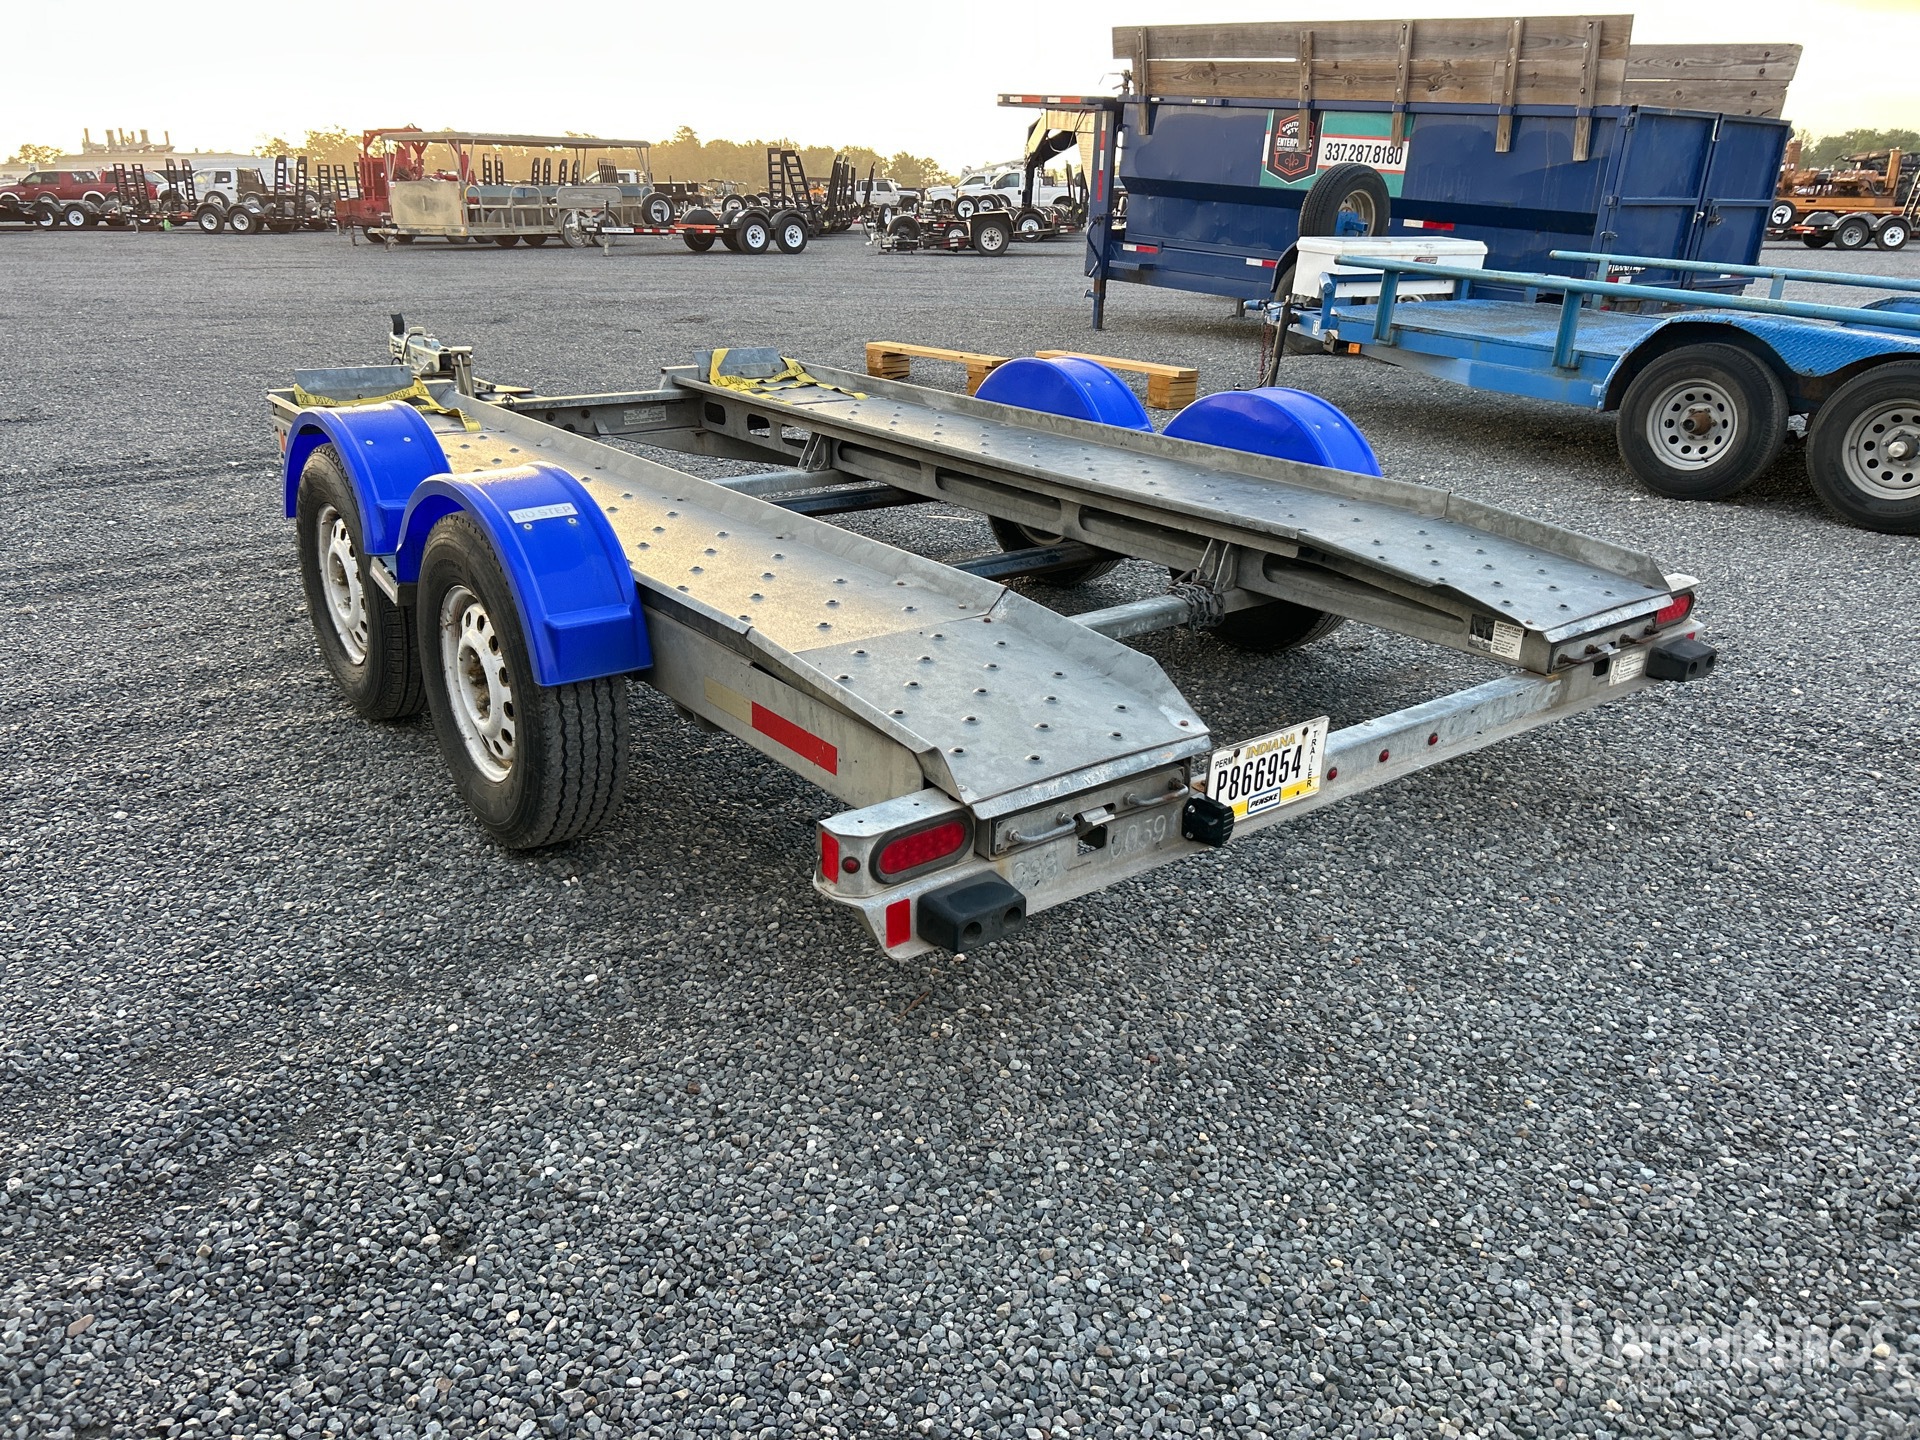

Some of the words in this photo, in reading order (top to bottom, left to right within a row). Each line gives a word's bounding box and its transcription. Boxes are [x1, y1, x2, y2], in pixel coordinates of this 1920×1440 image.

[1325, 142, 1403, 165] 337.287.8180
[514, 510, 535, 520] NO
[538, 505, 571, 516] STEP
[1245, 733, 1296, 759] INDIANA
[1214, 756, 1234, 769] PERM
[1306, 730, 1318, 787] TRAILER
[1216, 744, 1303, 801] P866954
[1250, 792, 1279, 809] PENSKE
